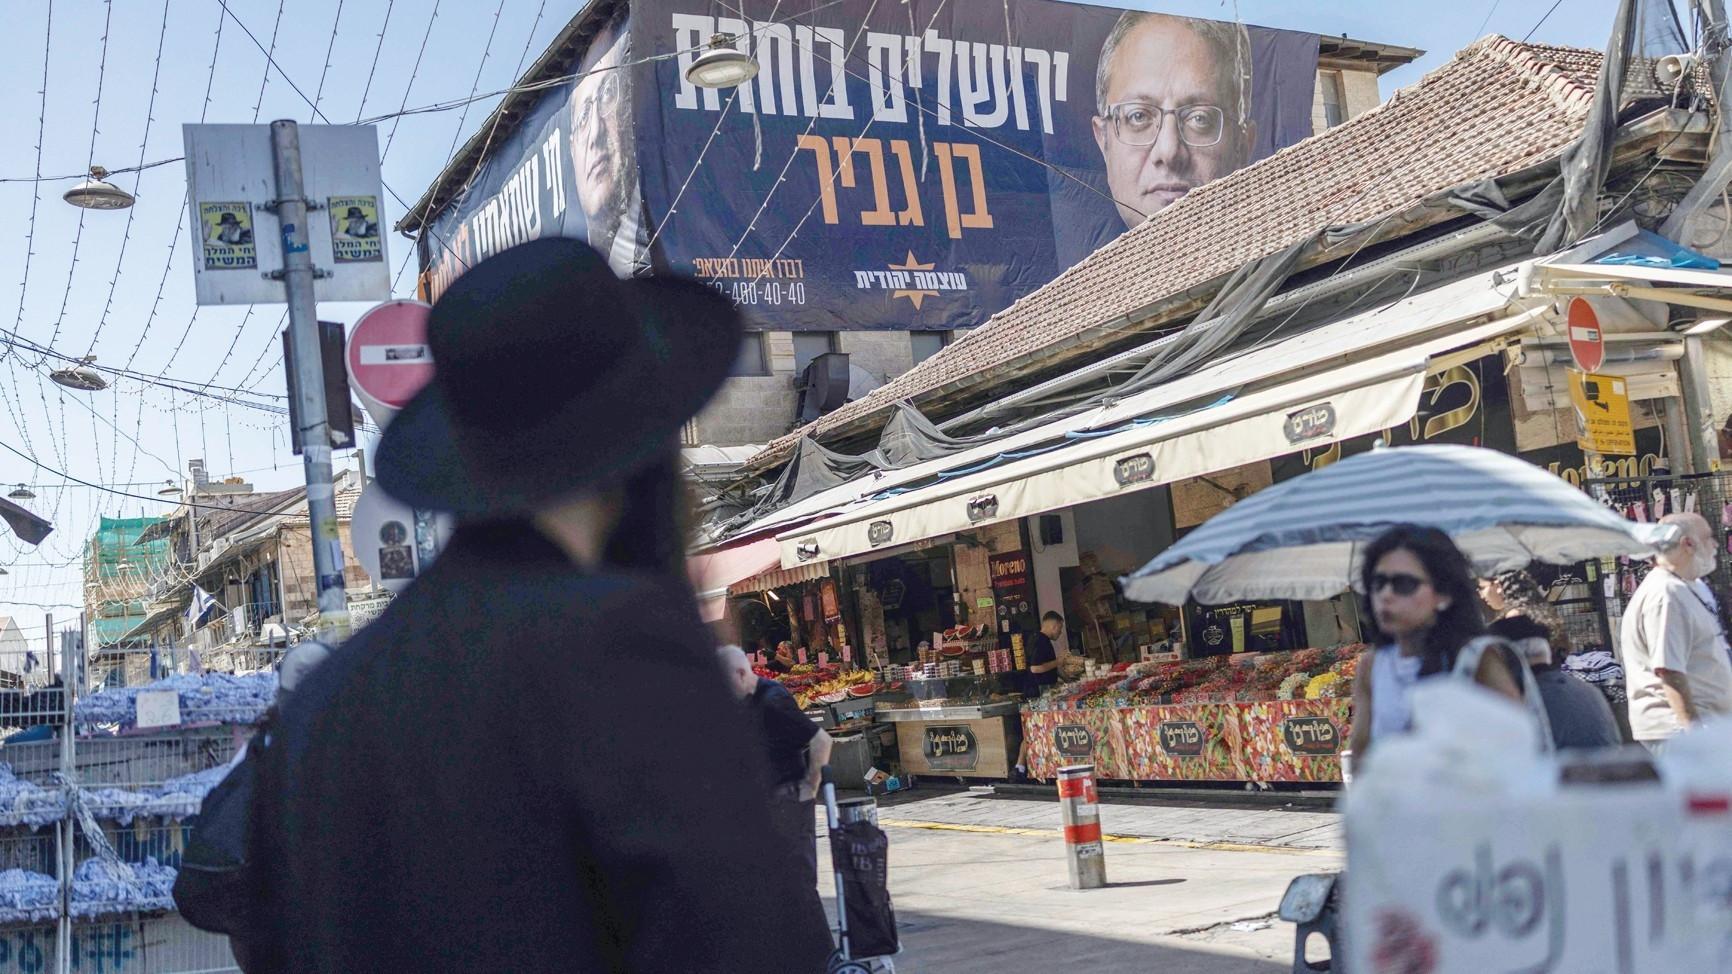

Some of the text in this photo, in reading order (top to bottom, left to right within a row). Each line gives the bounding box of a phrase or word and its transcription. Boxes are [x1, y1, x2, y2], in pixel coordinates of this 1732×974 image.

[672, 13, 1069, 134] ירושלים בוחרת
[543, 127, 566, 219] מי
[797, 134, 994, 239] בן גביר
[206, 256, 255, 265] המשיח
[741, 258, 775, 278] איתנו
[775, 259, 804, 279] דברו
[853, 270, 968, 290] עוצמה יהודית
[991, 559, 1026, 577] Moreno
